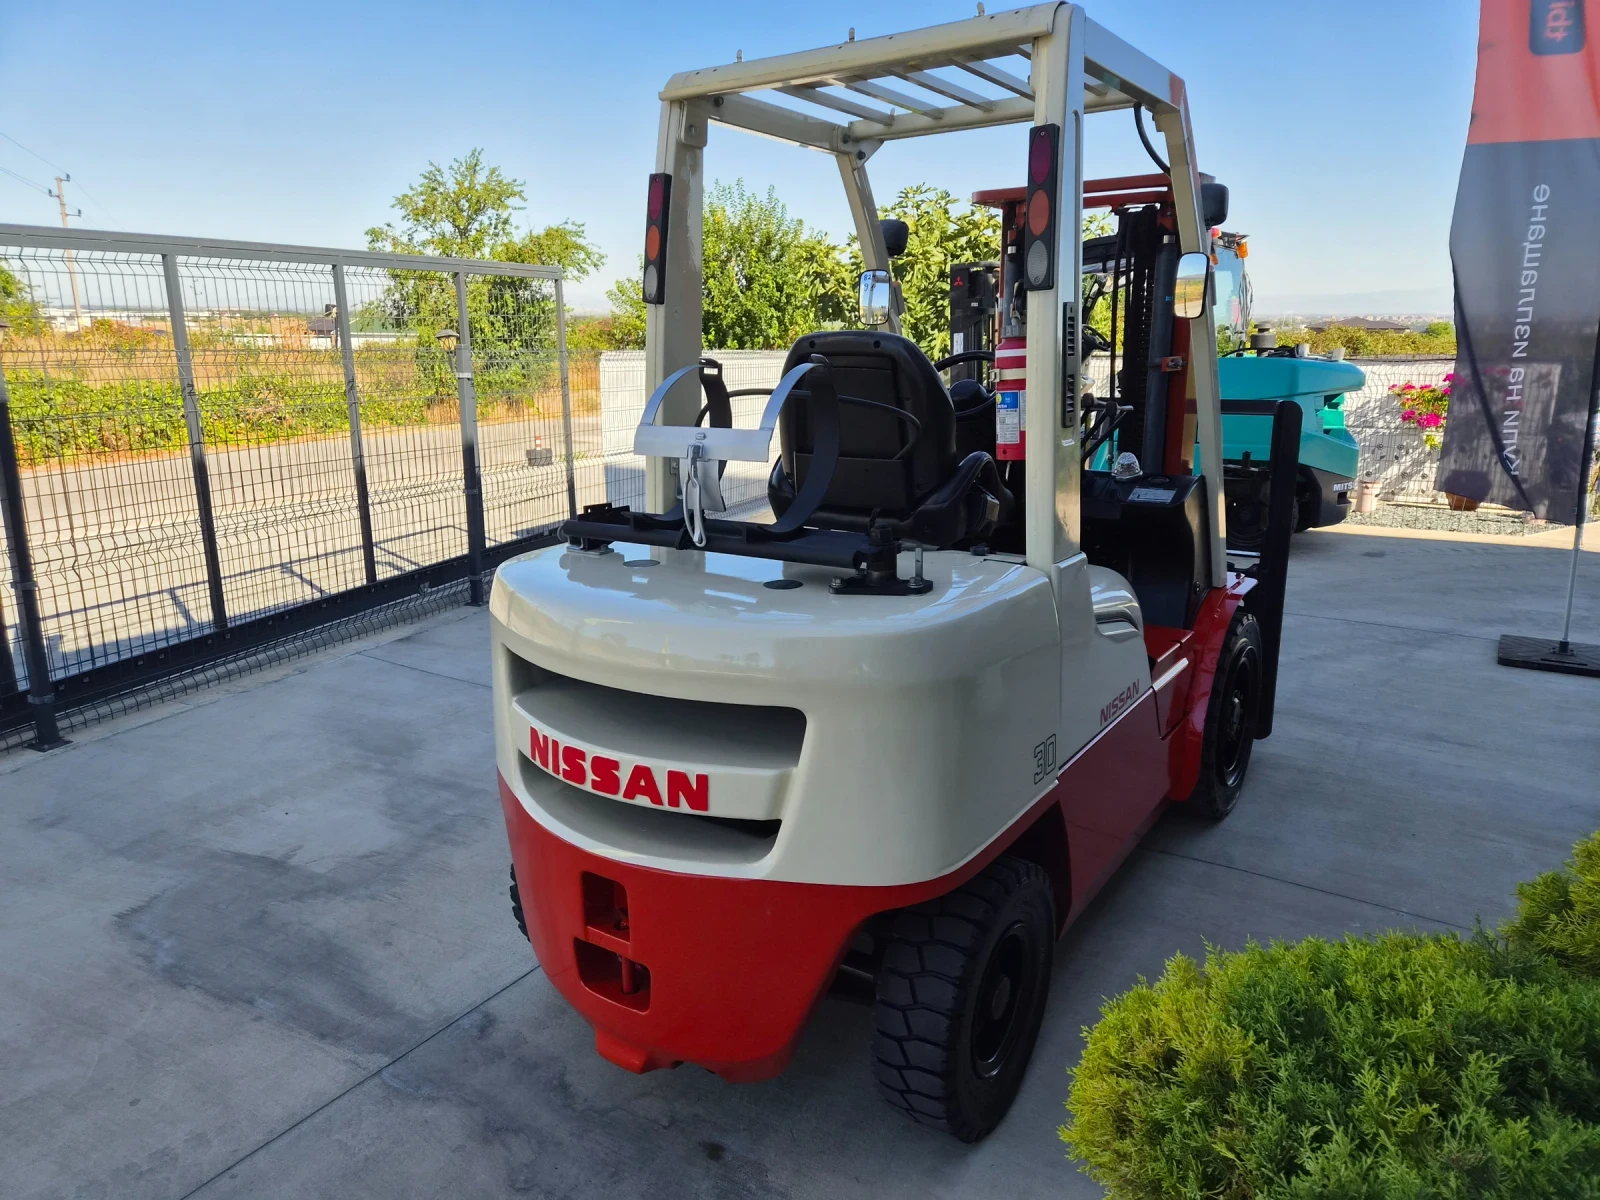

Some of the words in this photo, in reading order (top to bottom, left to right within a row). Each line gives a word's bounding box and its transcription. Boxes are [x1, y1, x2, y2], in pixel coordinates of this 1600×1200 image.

[1333, 481, 1355, 492] MITS
[1100, 679, 1140, 727] NISSAN
[530, 726, 709, 812] NISSAN
[1033, 733, 1057, 786] 30
